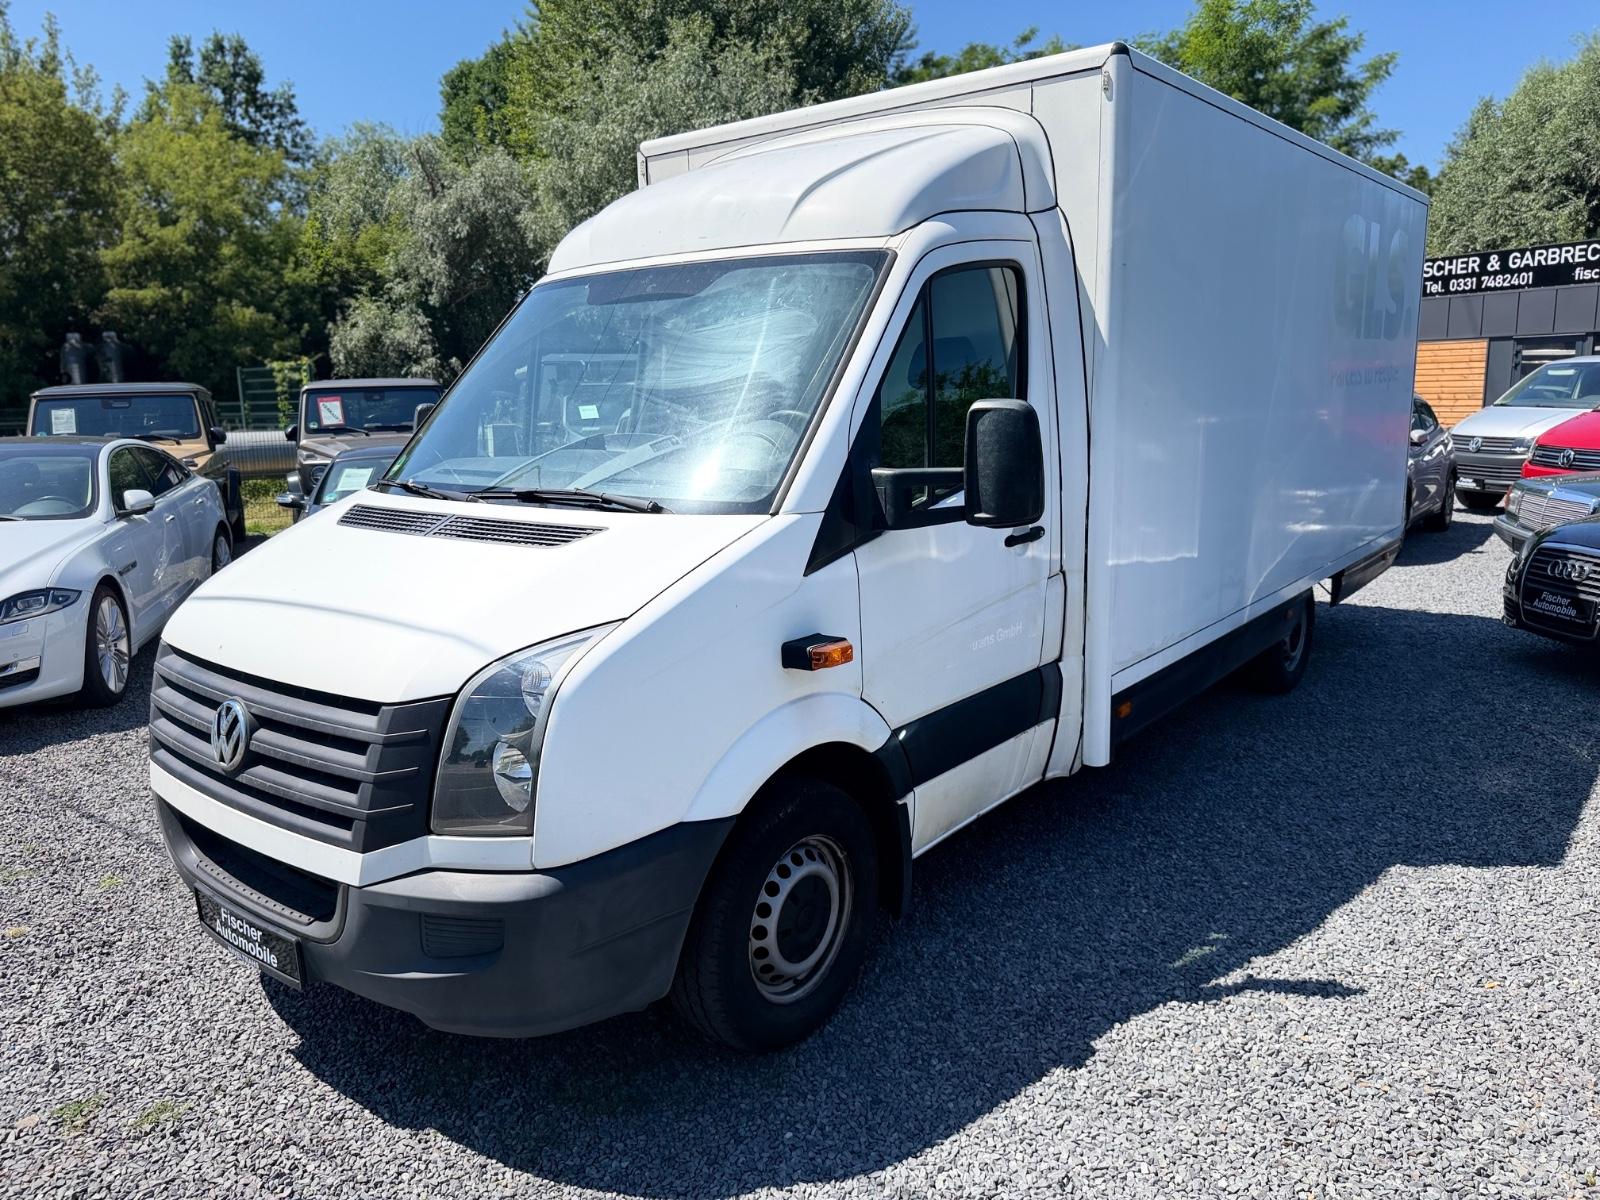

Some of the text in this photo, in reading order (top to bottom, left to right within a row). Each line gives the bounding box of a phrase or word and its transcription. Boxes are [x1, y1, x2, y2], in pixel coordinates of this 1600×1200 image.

[1424, 243, 1600, 278] SCHER & GARBREC
[1425, 271, 1533, 294] Tel. 0331 7482401
[1574, 267, 1600, 281] fisc
[1532, 598, 1577, 617] Automobile
[1541, 591, 1571, 606] Fischer
[220, 907, 263, 943] Fischer
[215, 918, 278, 968] Automobile
